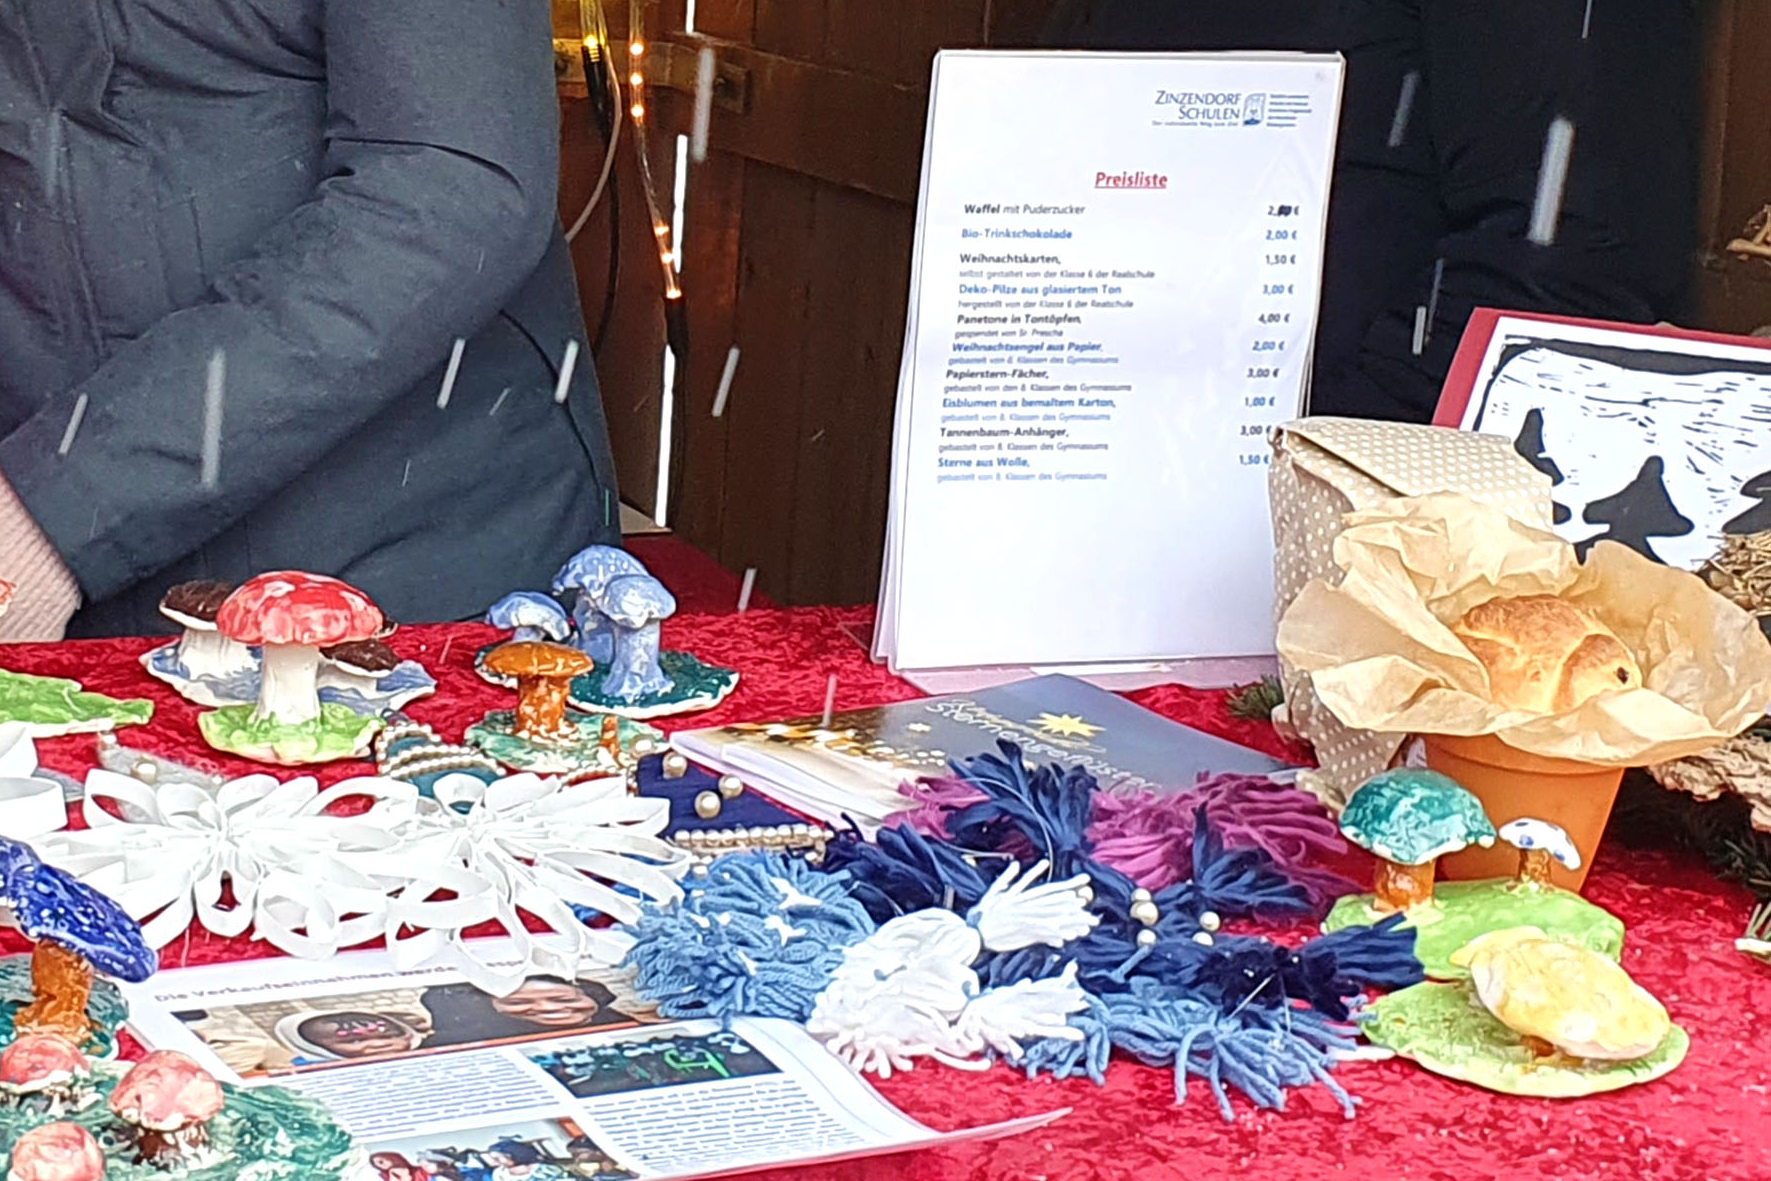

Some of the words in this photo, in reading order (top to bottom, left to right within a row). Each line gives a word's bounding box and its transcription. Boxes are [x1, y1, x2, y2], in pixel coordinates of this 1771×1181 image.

[1155, 90, 1241, 105] ZINZENDORF
[1178, 106, 1240, 119] SCHULEN
[1095, 172, 1168, 189] Preisliste
[965, 204, 1000, 214] Waffel
[1003, 205, 1019, 214] mit
[1023, 204, 1085, 214] Puderzucker
[961, 228, 1072, 239] Bio-Trinkschokolade
[1266, 230, 1288, 240] 2,00
[960, 253, 1061, 264] Weihnachtskarten,
[1266, 255, 1287, 265] 1,50
[959, 284, 1017, 294] Deko-Pilze
[1021, 286, 1038, 294] aus
[1042, 284, 1098, 296] glasiertem
[1102, 284, 1121, 294] Ton
[1262, 285, 1285, 295] 3,00
[1011, 315, 1021, 323] in
[1258, 314, 1281, 324] 4,00
[1252, 341, 1275, 351] 2,00
[1247, 368, 1270, 378] 3,00
[943, 398, 997, 407] Eisblumen
[1078, 398, 1116, 408] Karton,
[1245, 397, 1266, 407] 1,00
[940, 427, 1069, 438] Tannenbaum-Anhänger,
[1240, 425, 1263, 436] 3,00
[938, 458, 972, 467] Sterne
[1239, 454, 1261, 465] 1,50
[154, 993, 188, 1002] Die
[192, 971, 393, 998] Verkaufseinnahmen
[398, 965, 457, 977] werde
